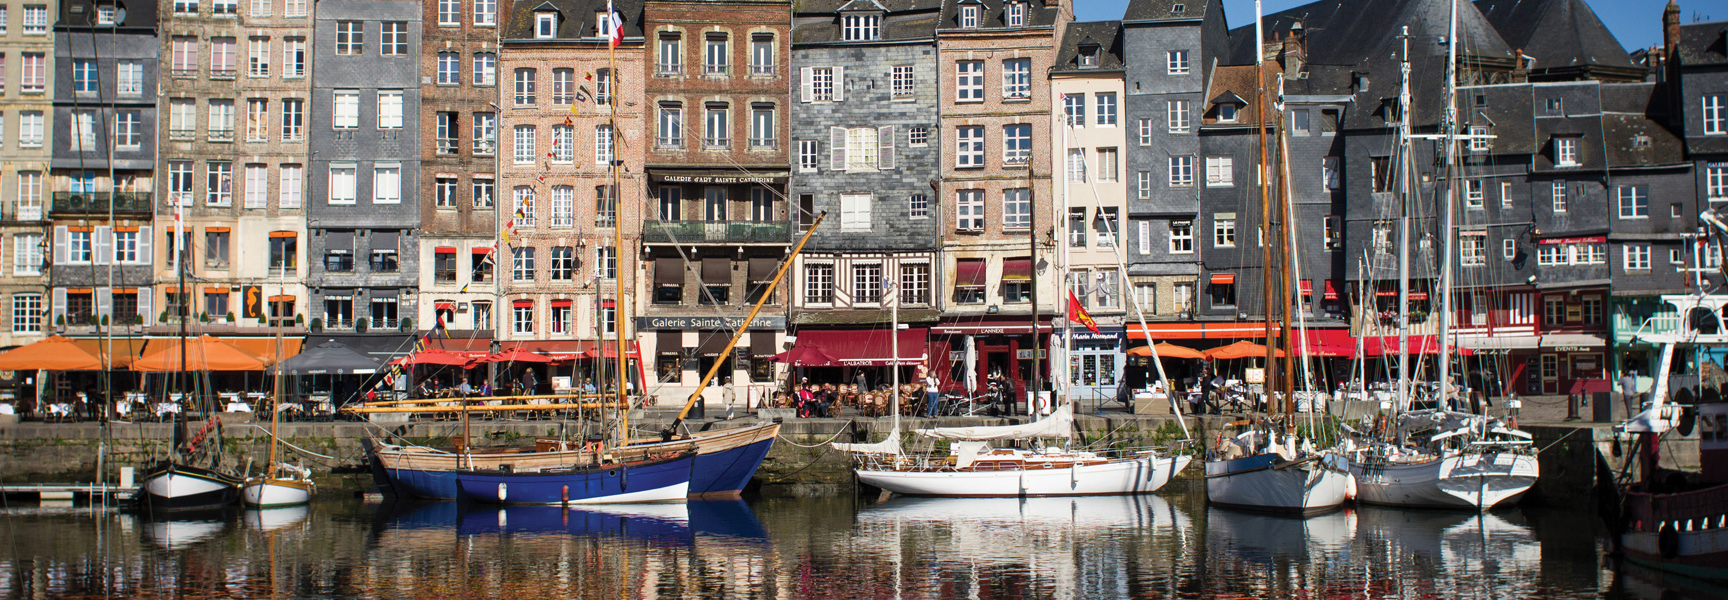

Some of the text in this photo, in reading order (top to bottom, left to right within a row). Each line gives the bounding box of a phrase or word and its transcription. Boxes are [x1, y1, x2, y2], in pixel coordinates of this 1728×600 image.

[652, 318, 772, 327] Galerie Sainte Catherine
